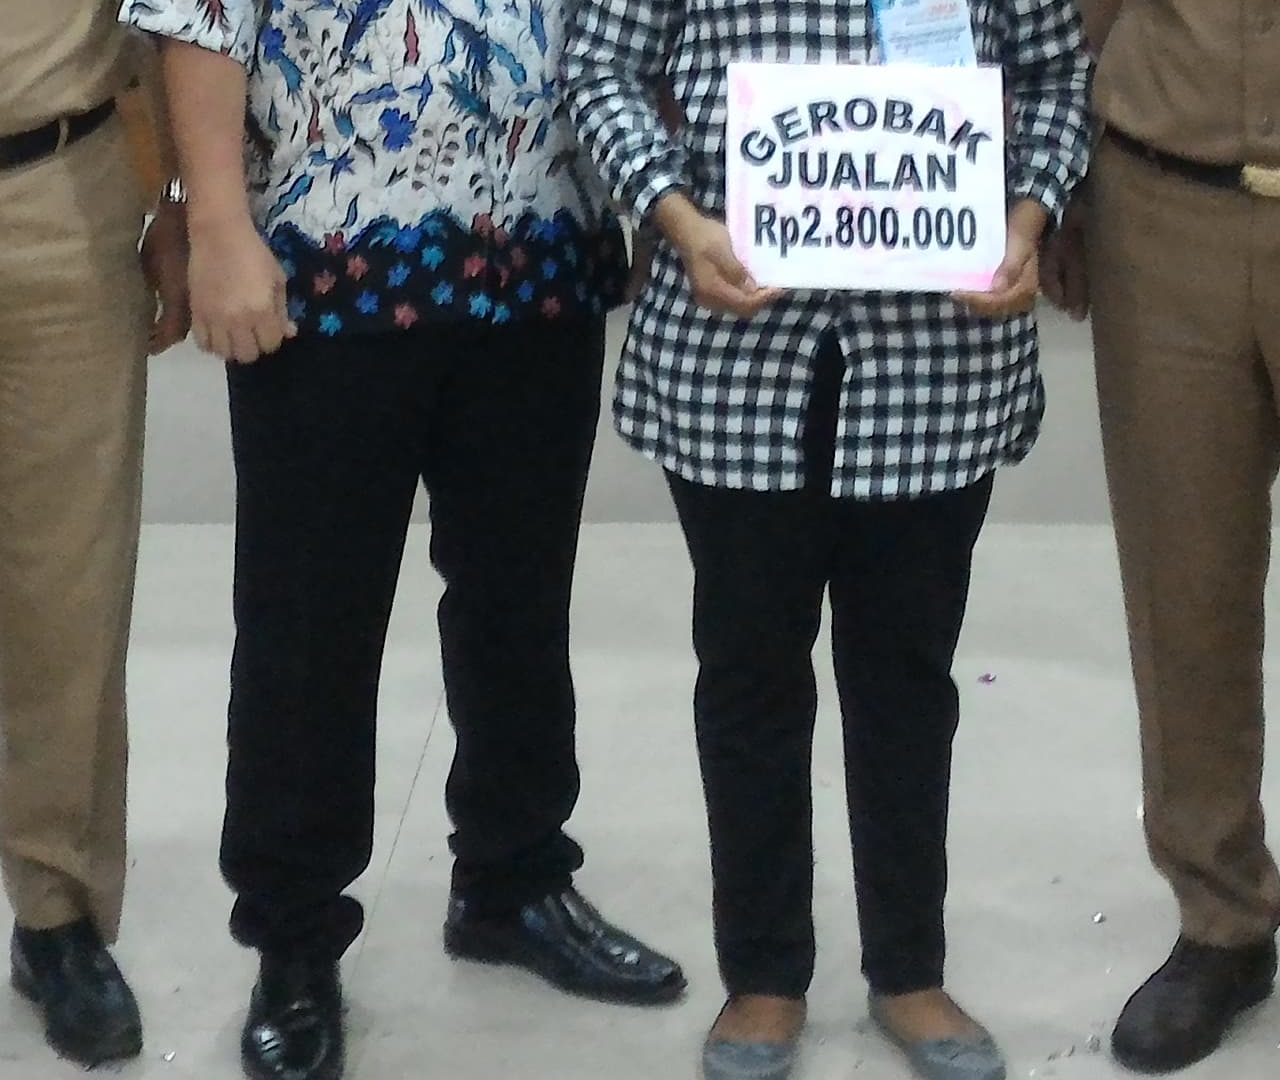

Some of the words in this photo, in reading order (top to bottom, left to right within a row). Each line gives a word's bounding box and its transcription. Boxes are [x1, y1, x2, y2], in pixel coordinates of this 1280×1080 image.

[739, 96, 993, 167] GEROBAK
[766, 150, 958, 193] JUALAN
[753, 203, 978, 259] Rp2.800.000
